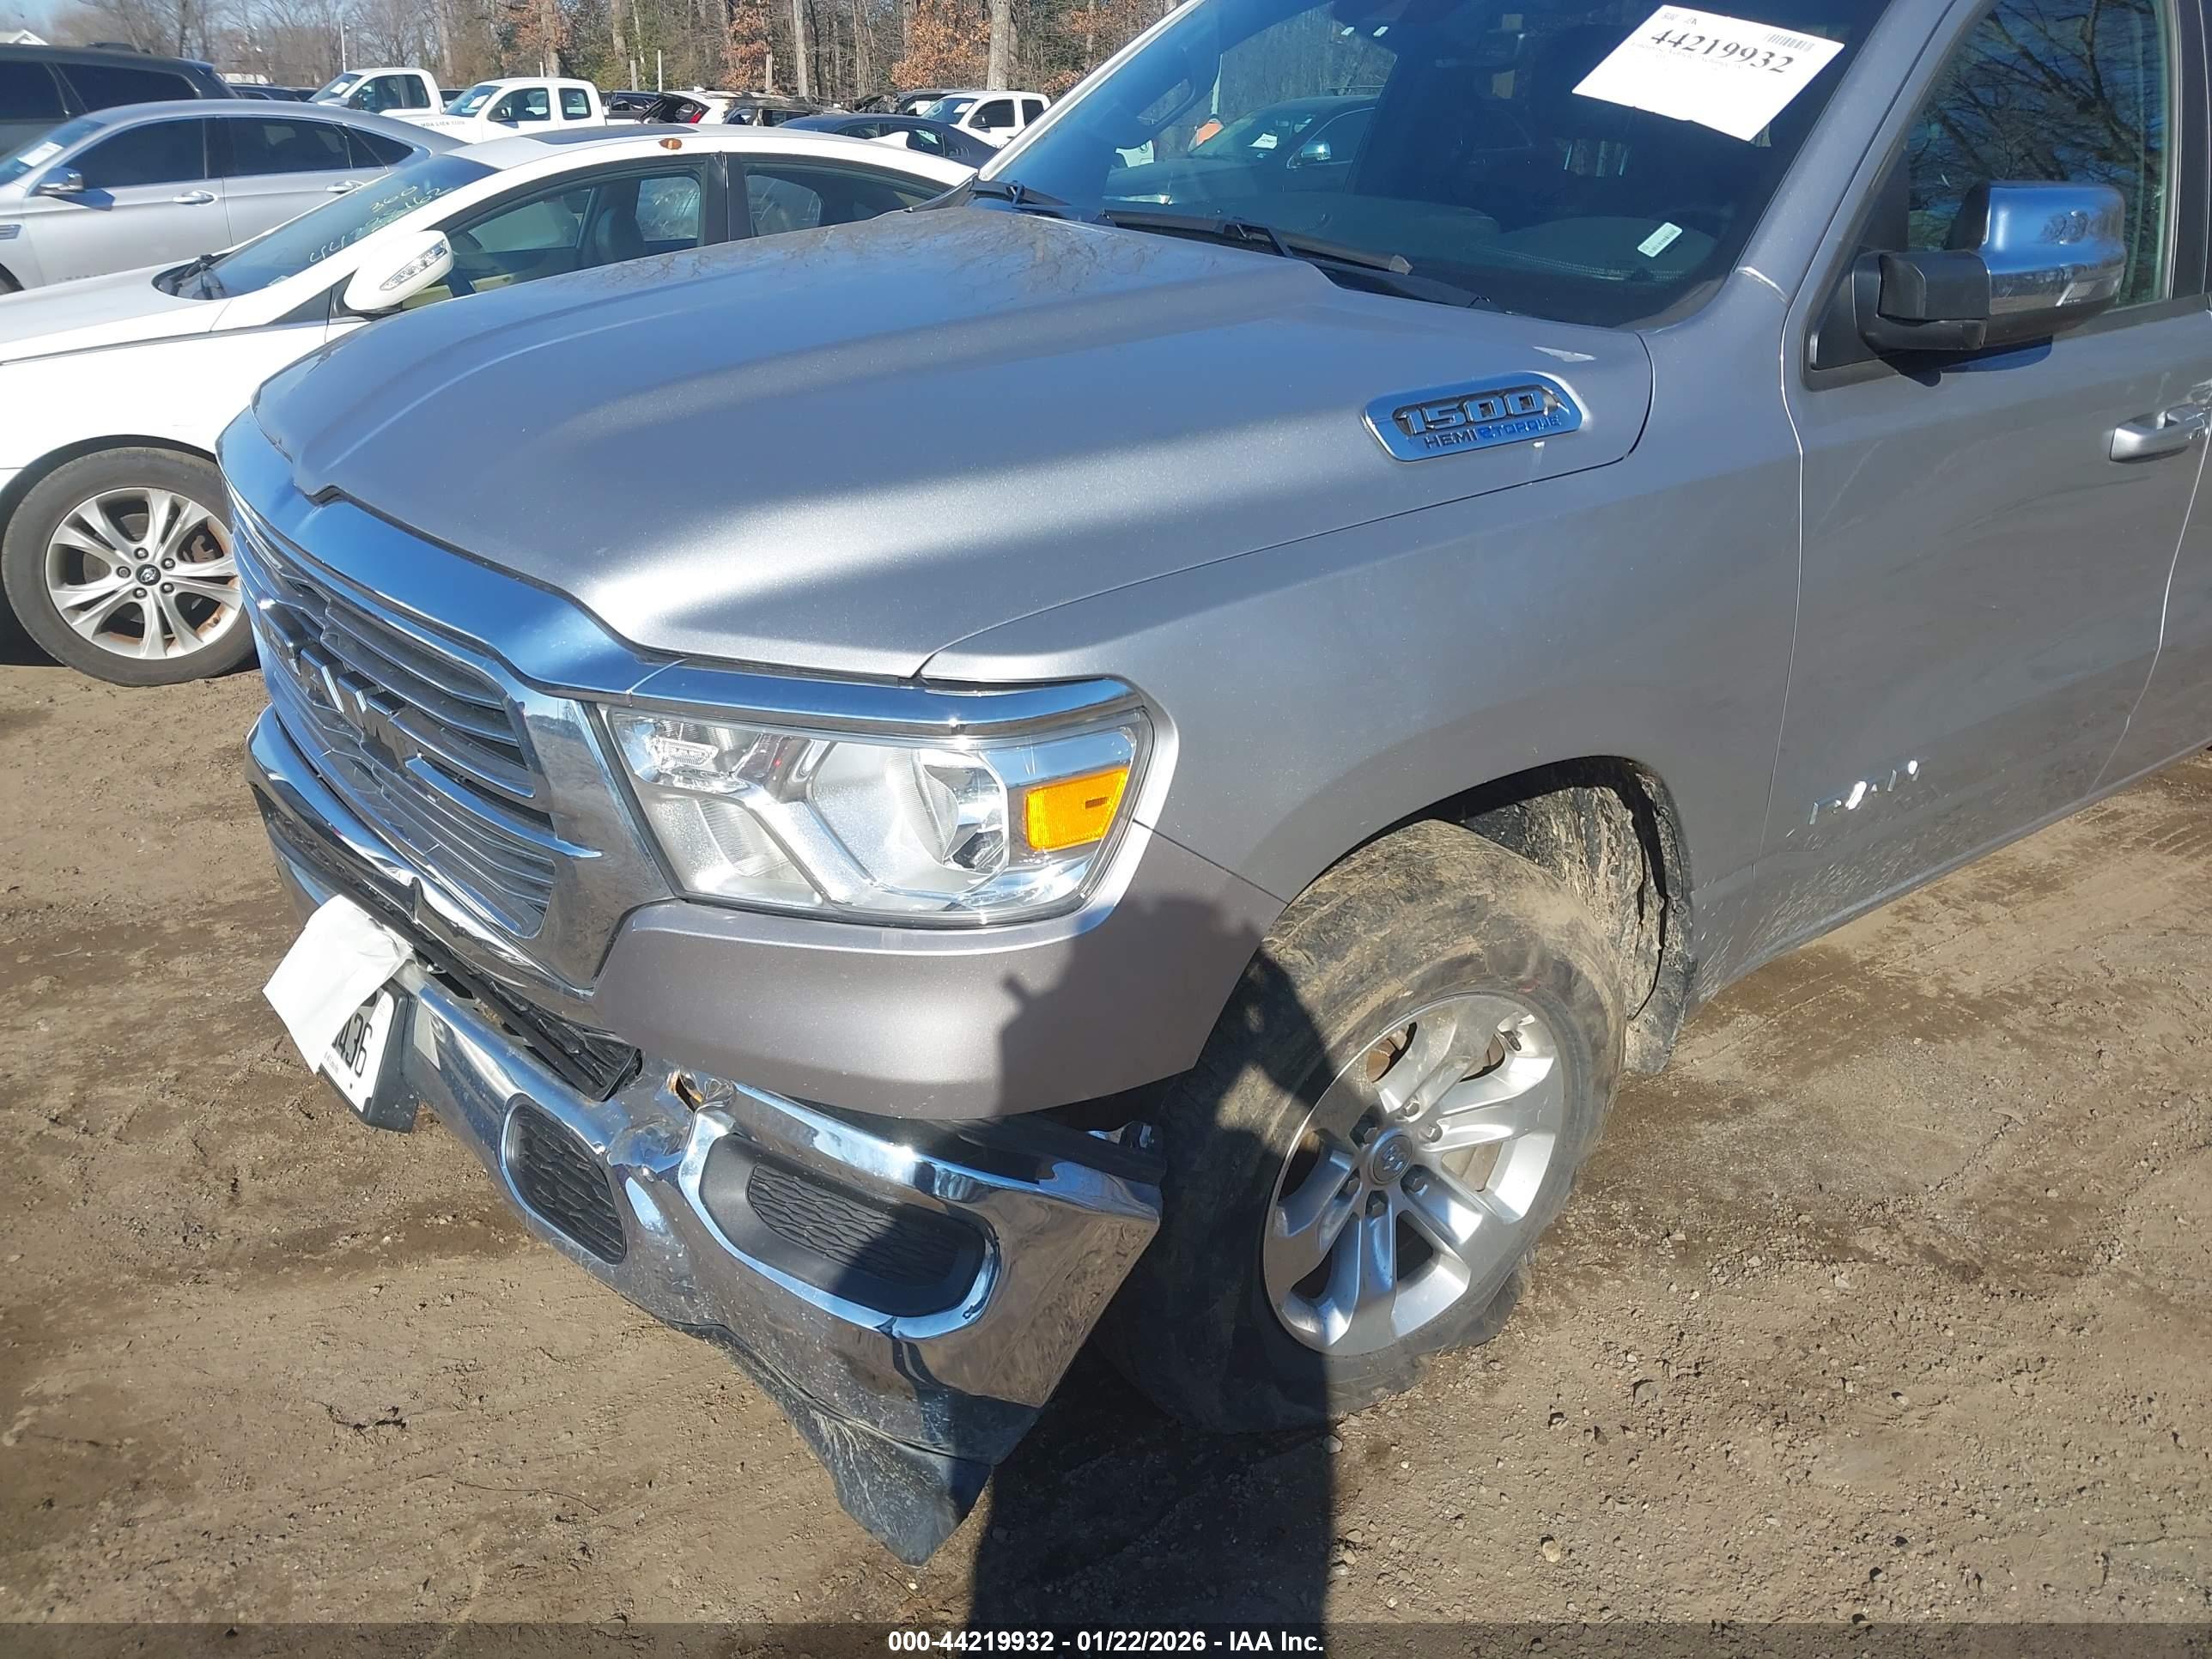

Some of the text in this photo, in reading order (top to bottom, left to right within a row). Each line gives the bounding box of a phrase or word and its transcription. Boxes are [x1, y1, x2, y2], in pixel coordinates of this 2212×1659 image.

[1650, 28, 1795, 74] 44219932
[1395, 388, 1547, 435] 1500
[1423, 428, 1479, 449] HEMI
